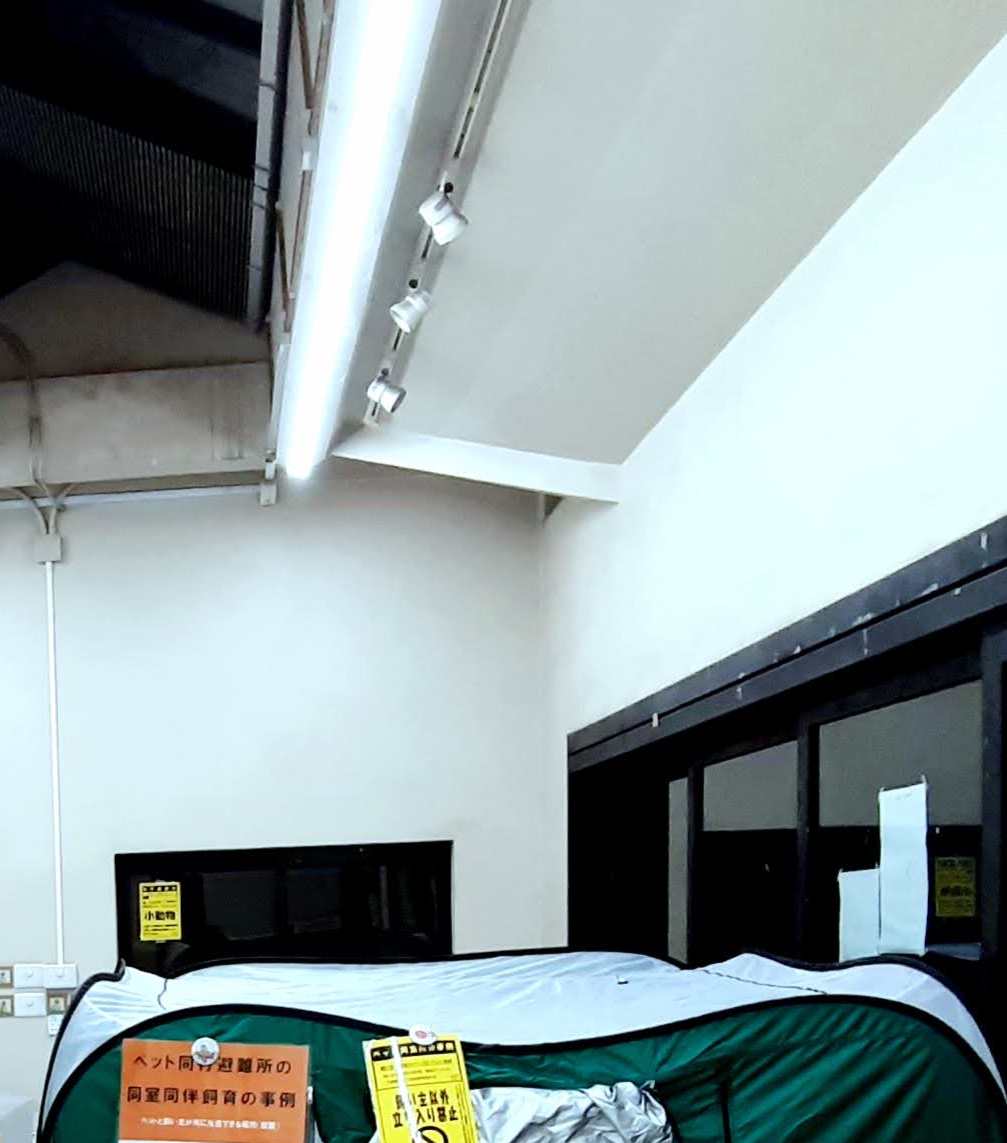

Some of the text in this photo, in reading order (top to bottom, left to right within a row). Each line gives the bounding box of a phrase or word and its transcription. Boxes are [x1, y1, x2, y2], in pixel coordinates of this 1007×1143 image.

[127, 1086, 297, 1109] 同室同伴飼育の事例
[392, 1105, 459, 1129] 立入り禁止
